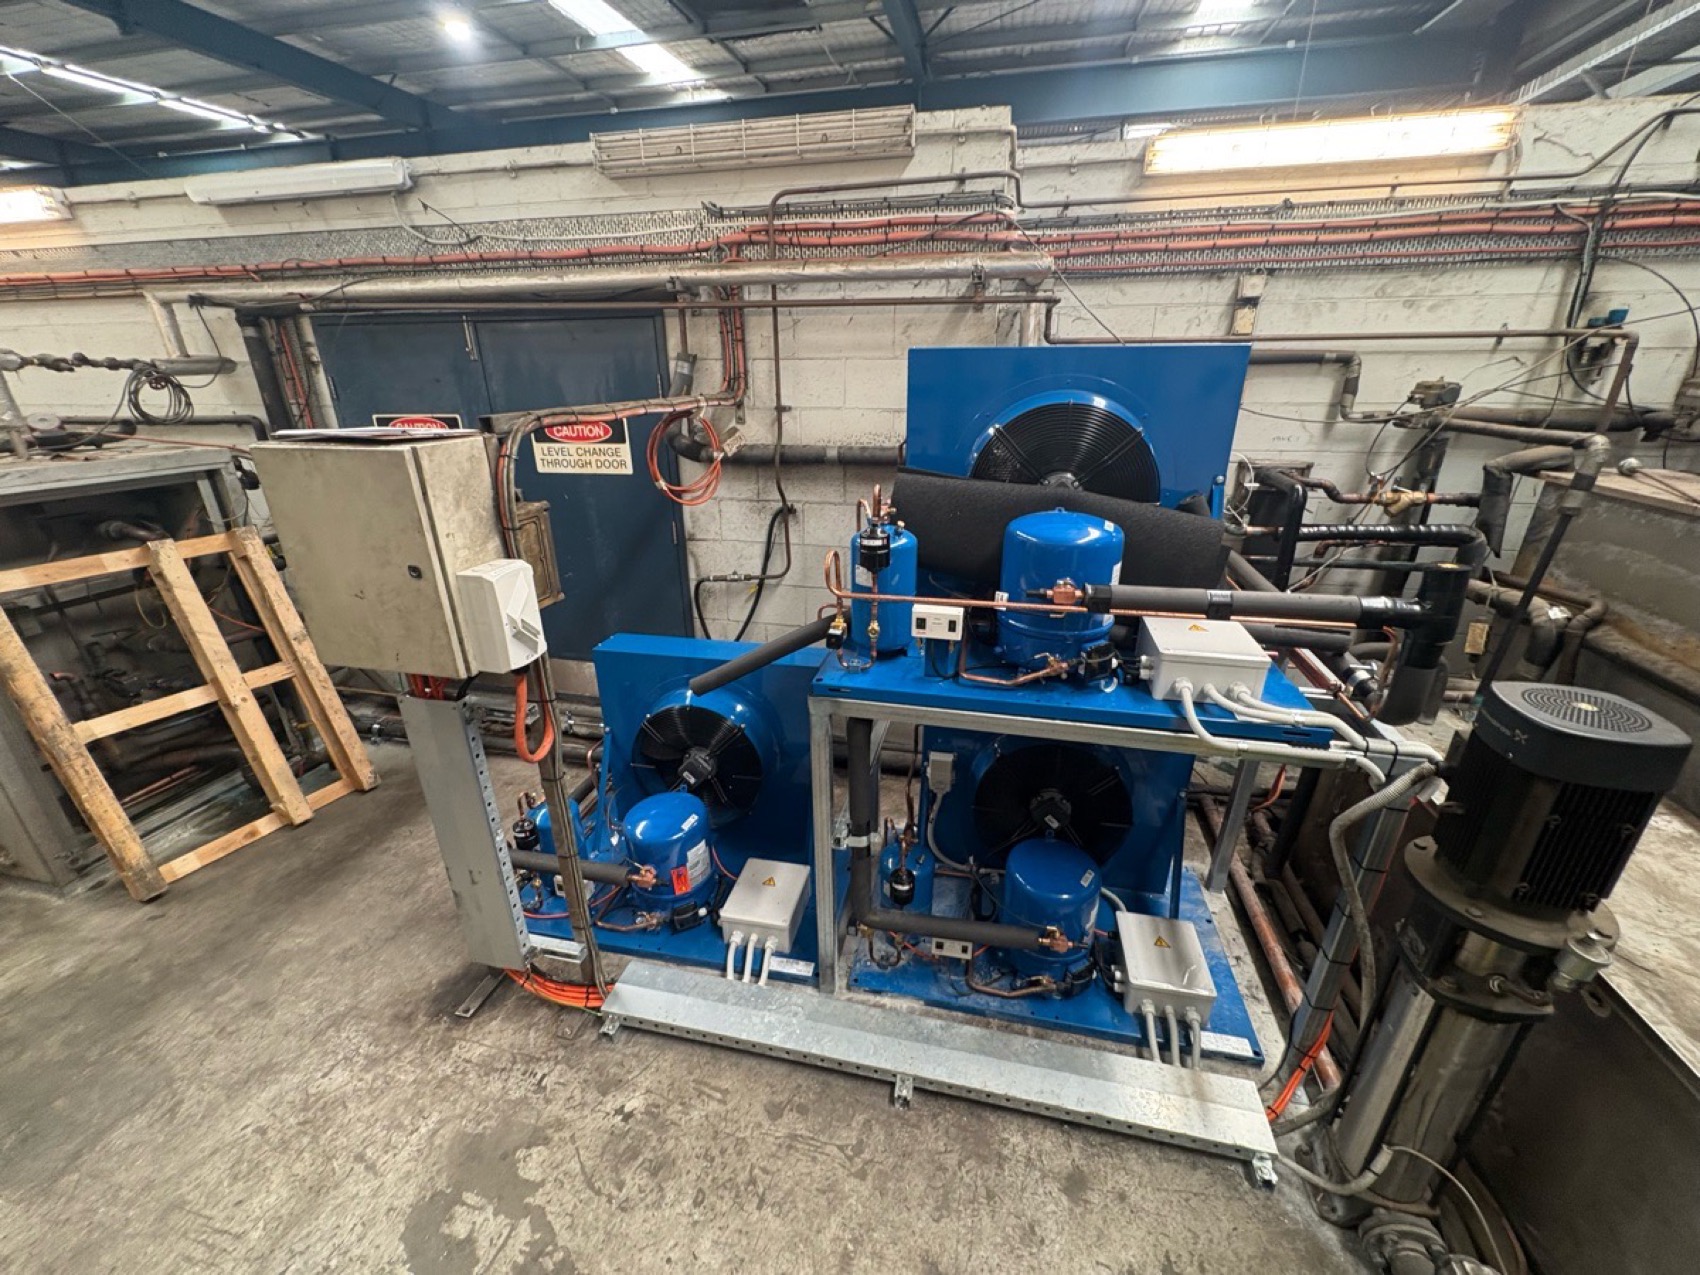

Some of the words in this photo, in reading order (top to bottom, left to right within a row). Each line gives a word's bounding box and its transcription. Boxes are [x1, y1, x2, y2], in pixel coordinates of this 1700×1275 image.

[553, 424, 604, 437] CAUTION
[541, 446, 574, 456] LEVEL
[575, 447, 622, 457] CHANGE
[540, 458, 592, 468] THROUGH
[595, 460, 628, 469] DOOR
